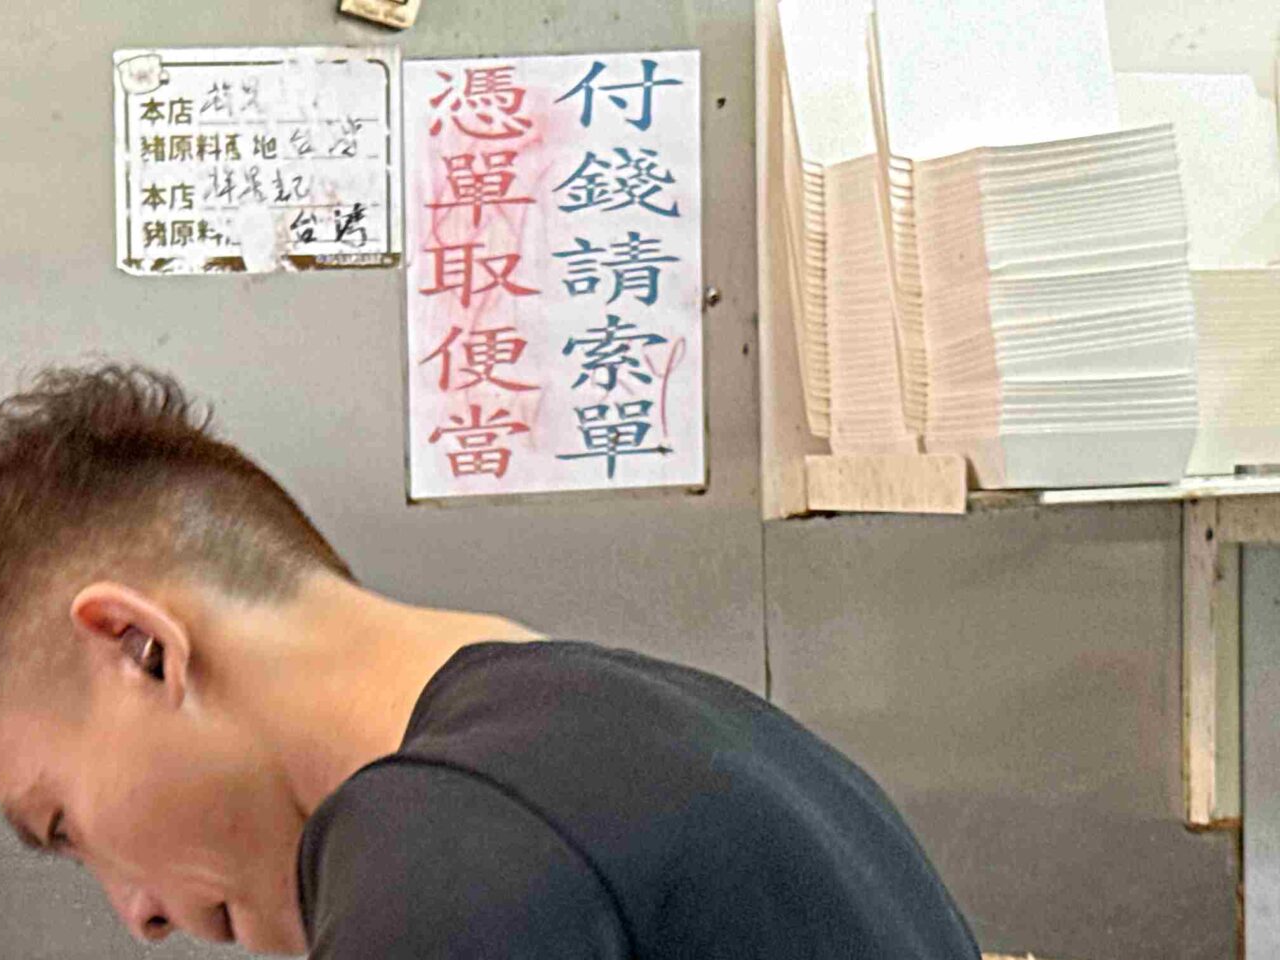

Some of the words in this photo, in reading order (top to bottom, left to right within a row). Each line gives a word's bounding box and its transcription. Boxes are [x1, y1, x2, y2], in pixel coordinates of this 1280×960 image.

[139, 96, 193, 126] 本店
[140, 182, 195, 212] 本店
[418, 65, 543, 480] 憑單取便當
[552, 57, 684, 480] 付錢請索單
